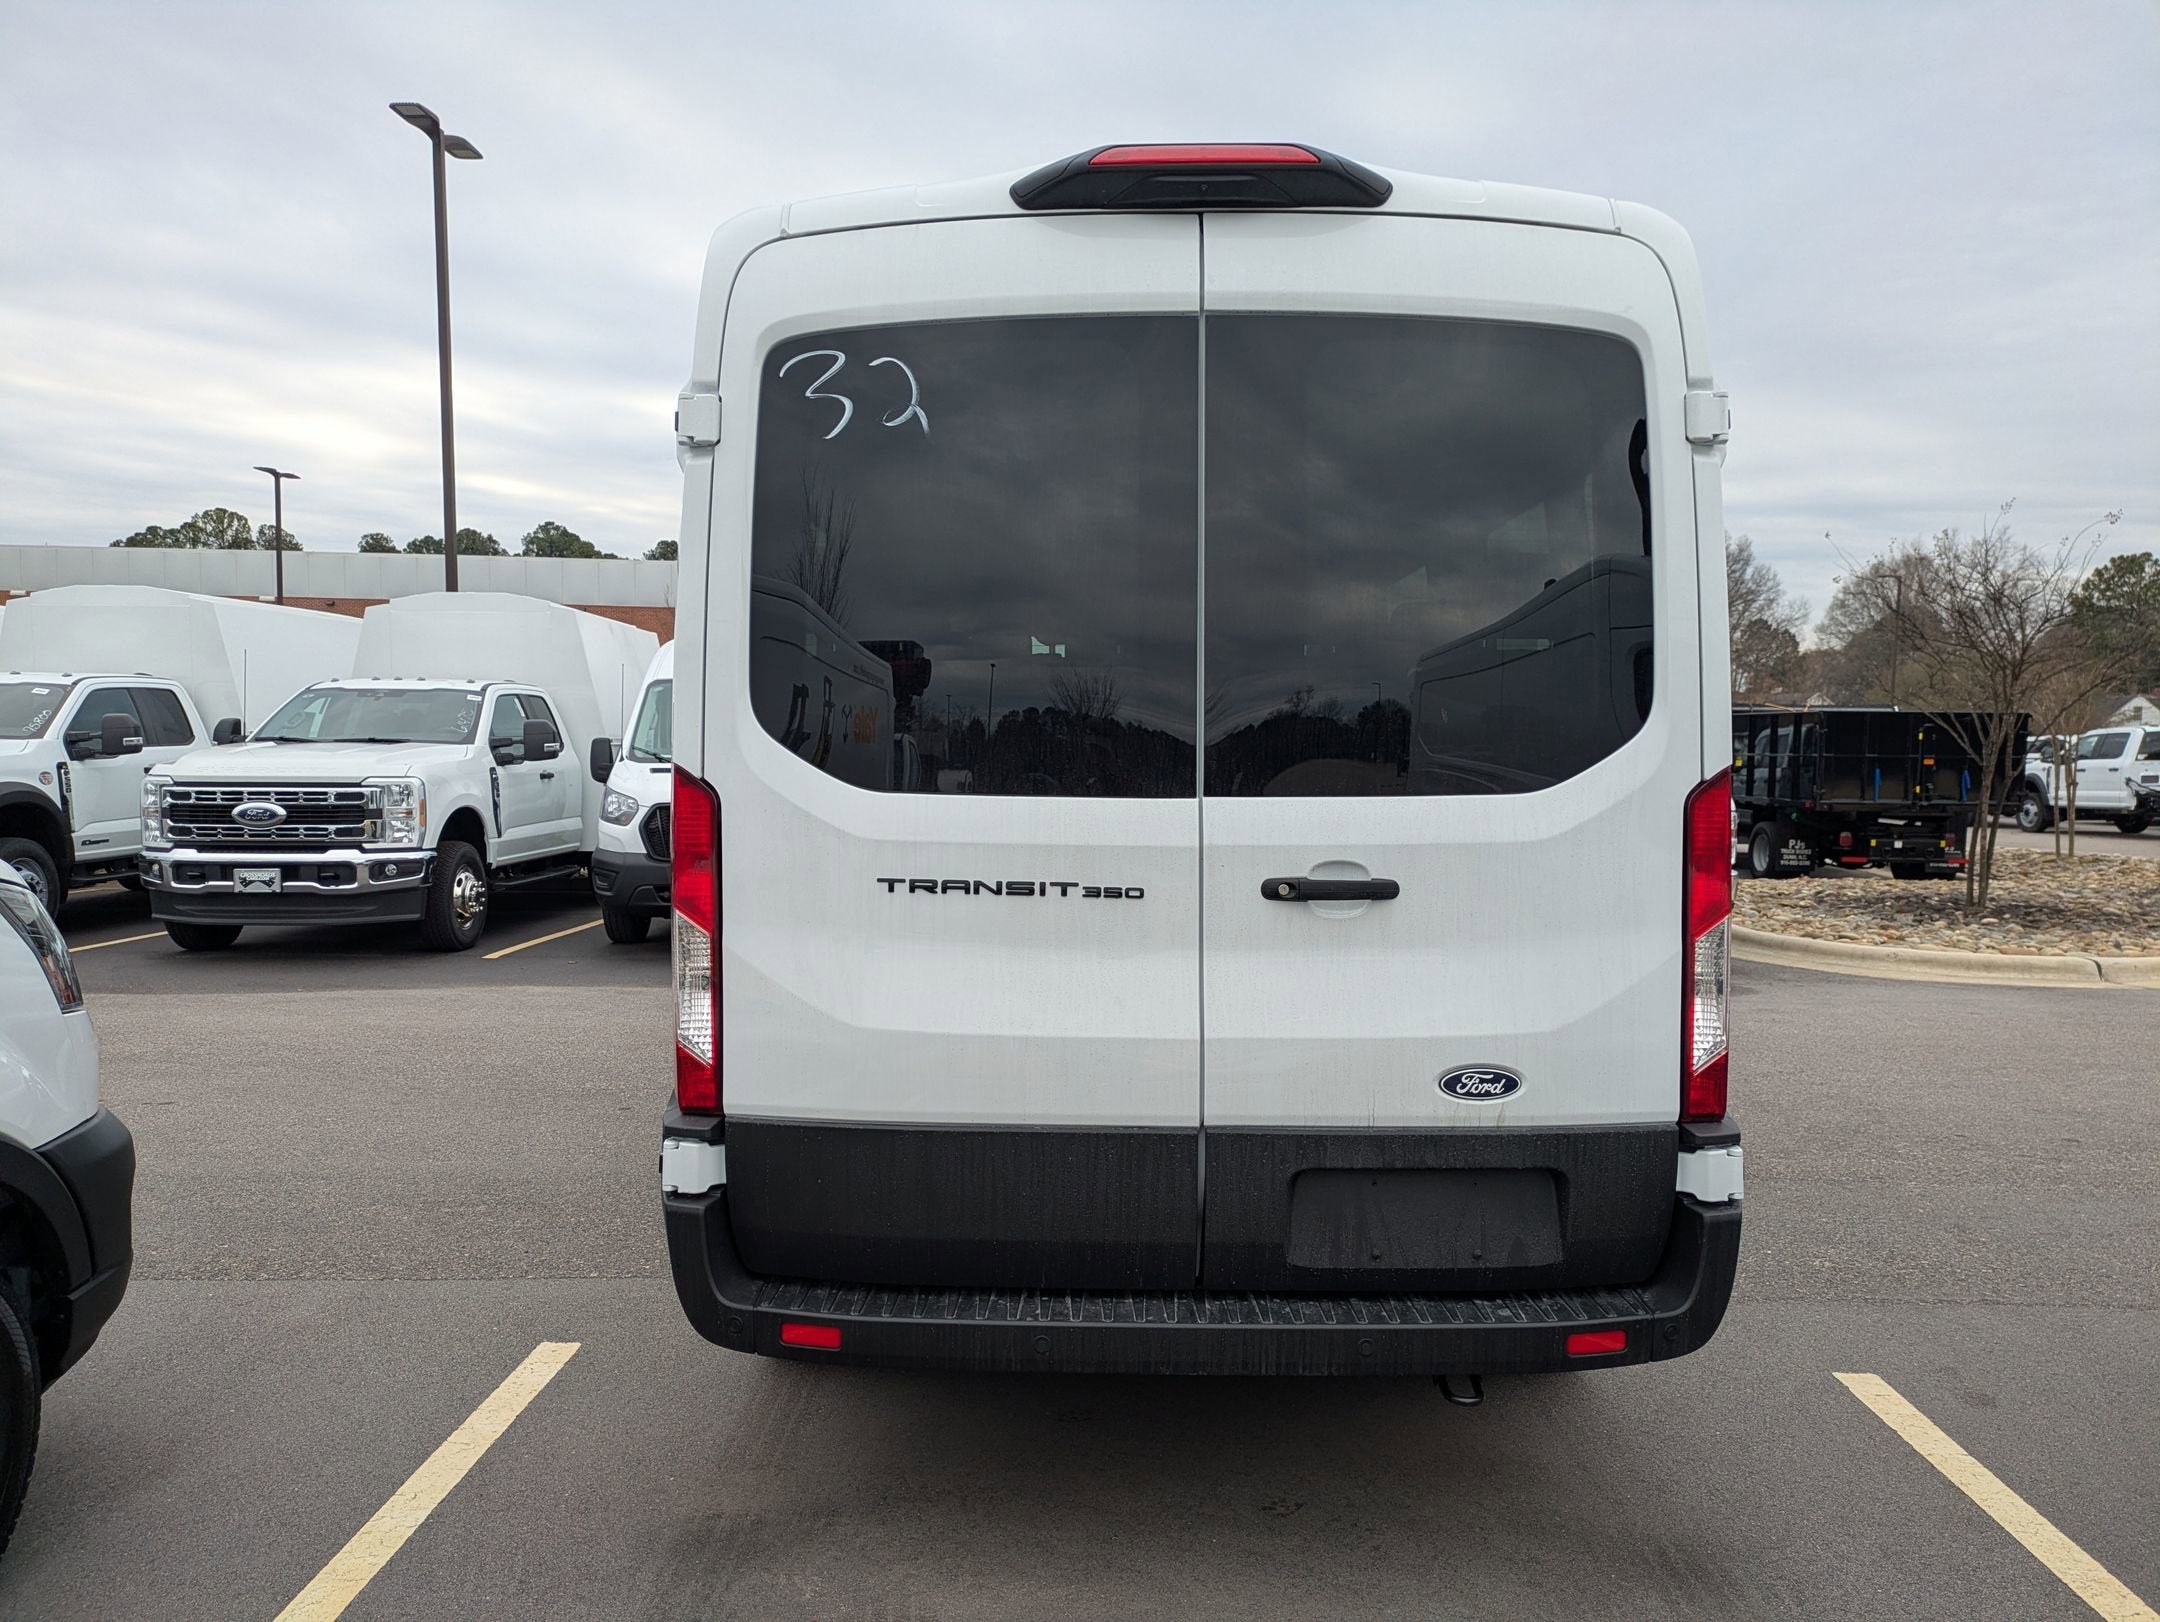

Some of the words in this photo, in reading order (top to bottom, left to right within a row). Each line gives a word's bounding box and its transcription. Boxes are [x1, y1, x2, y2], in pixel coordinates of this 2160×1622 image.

[779, 350, 931, 440] 32
[876, 877, 1079, 898] TRANSIT
[1082, 886, 1145, 899] 350
[1456, 1073, 1507, 1094] Ford
